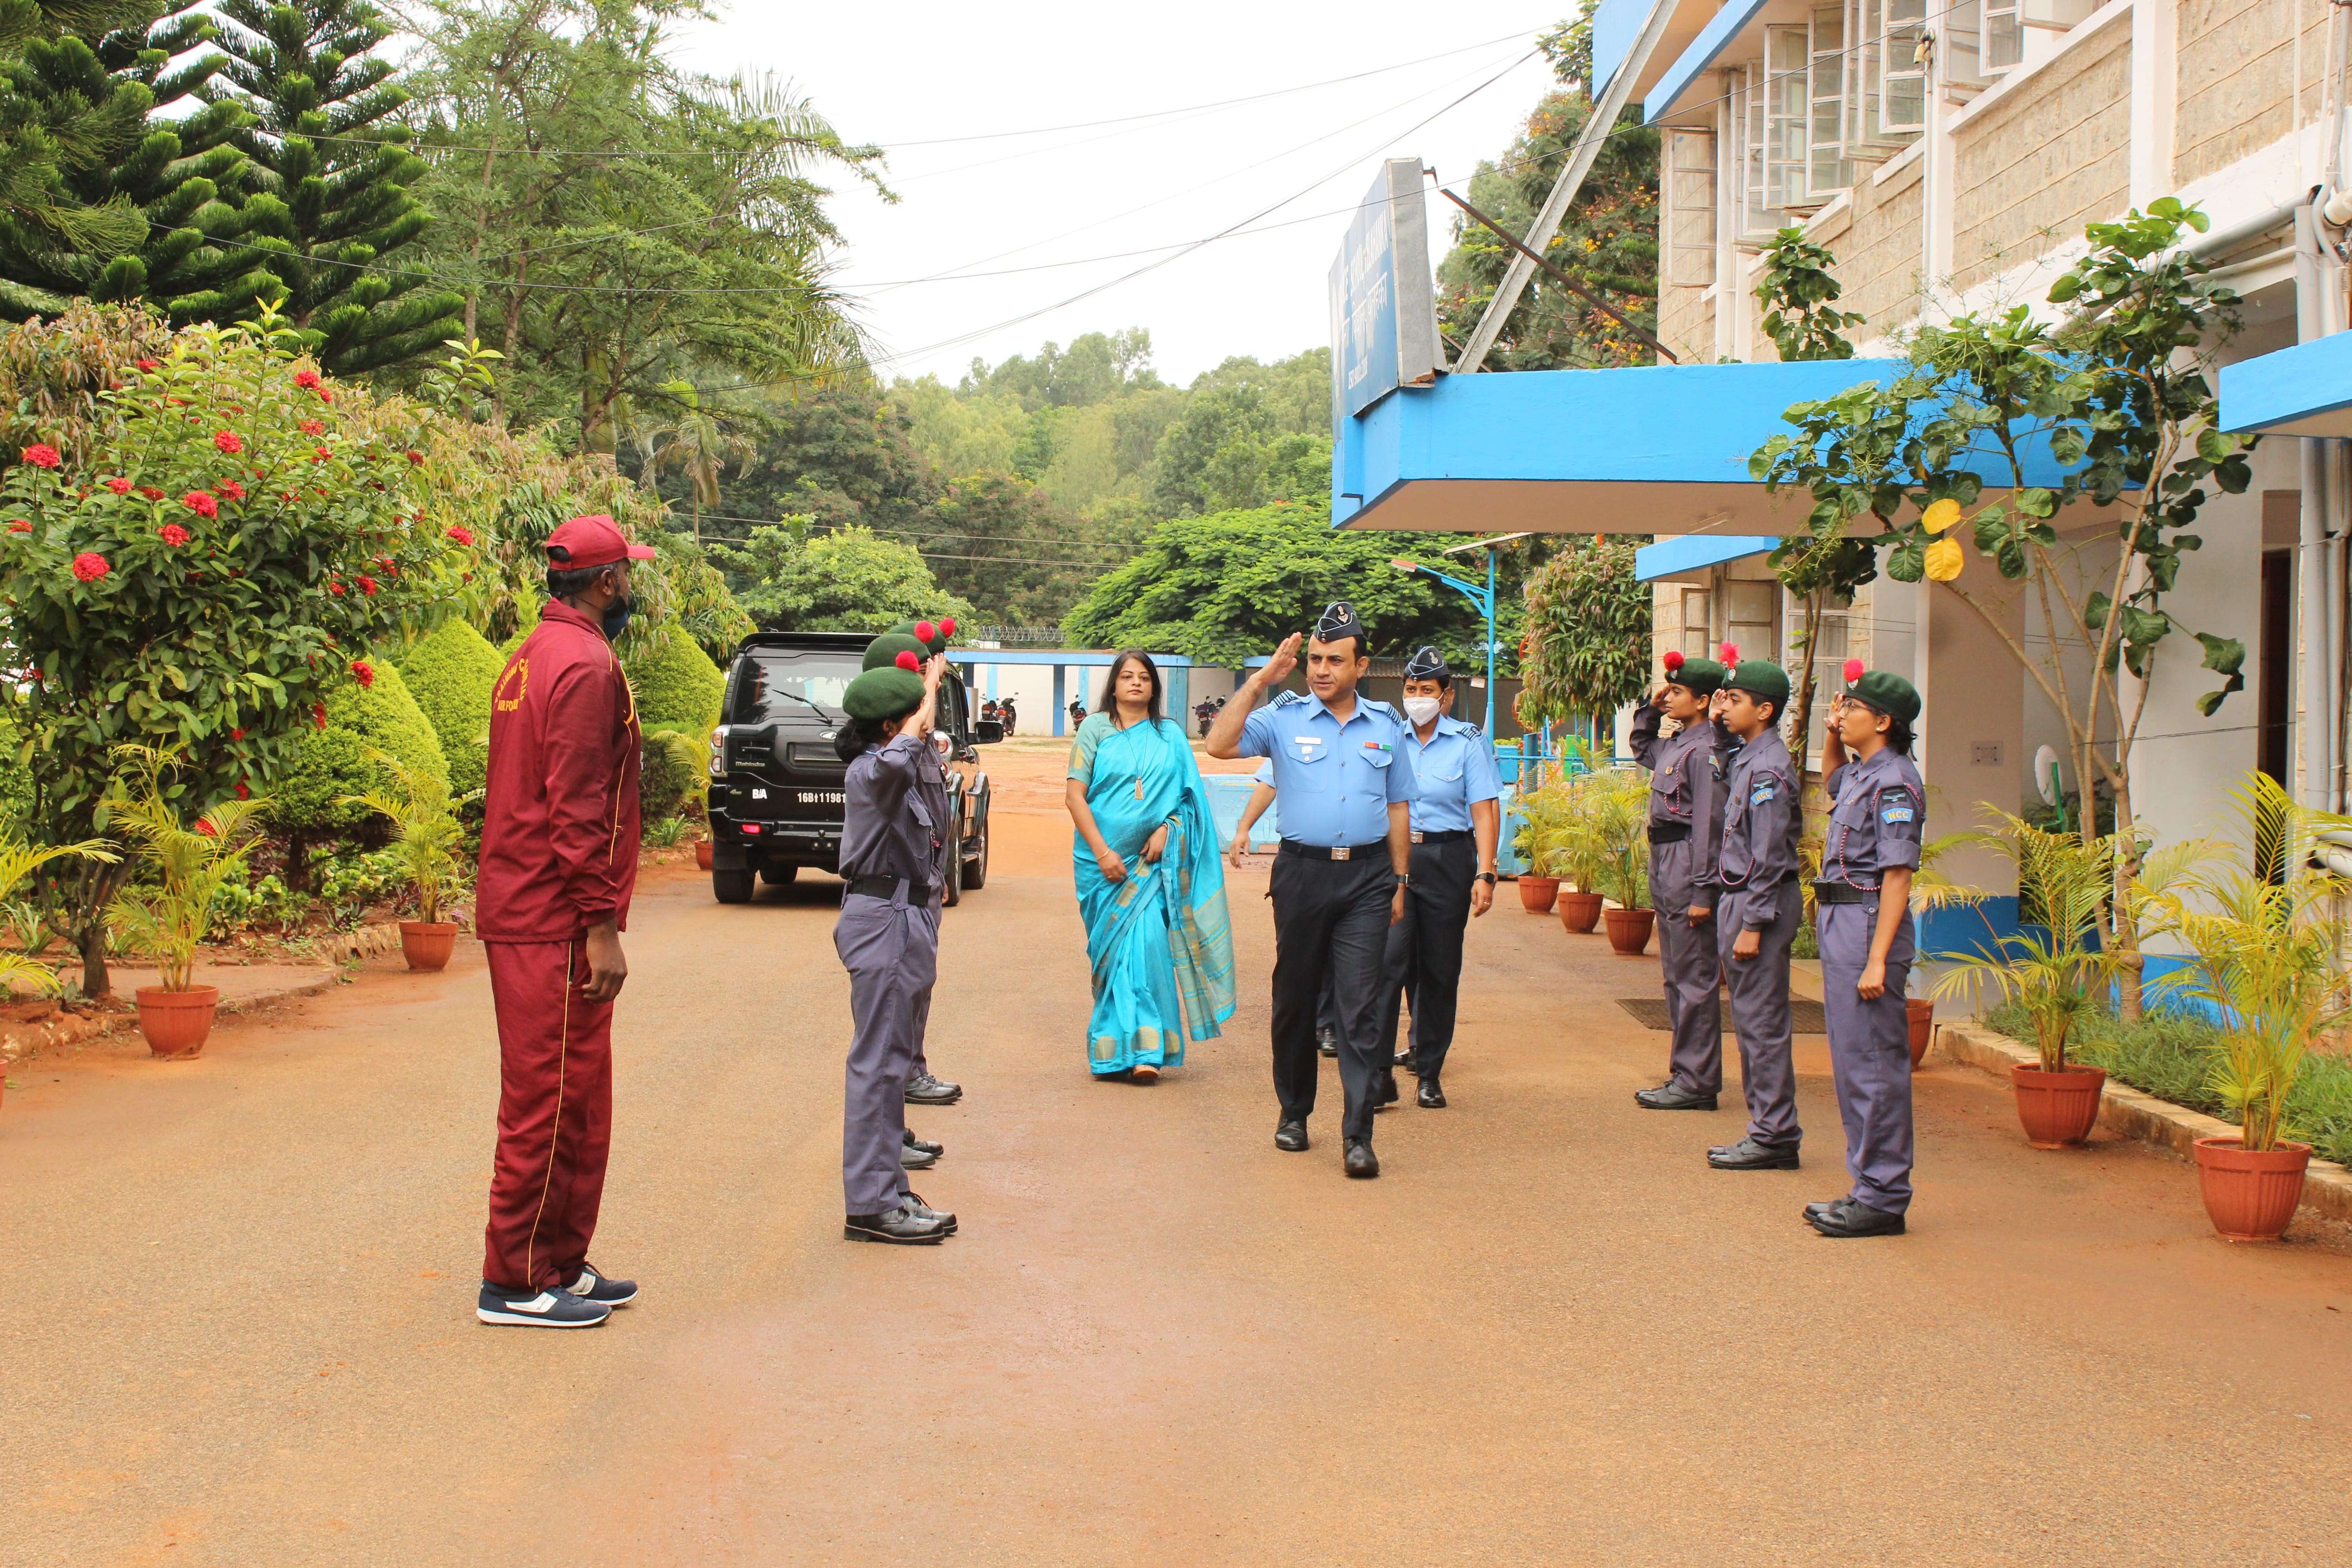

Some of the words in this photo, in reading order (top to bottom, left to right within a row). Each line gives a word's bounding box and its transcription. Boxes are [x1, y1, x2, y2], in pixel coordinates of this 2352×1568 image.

[752, 789, 767, 799] B/A
[1754, 791, 1771, 801] NCC
[1888, 810, 1909, 820] NCC
